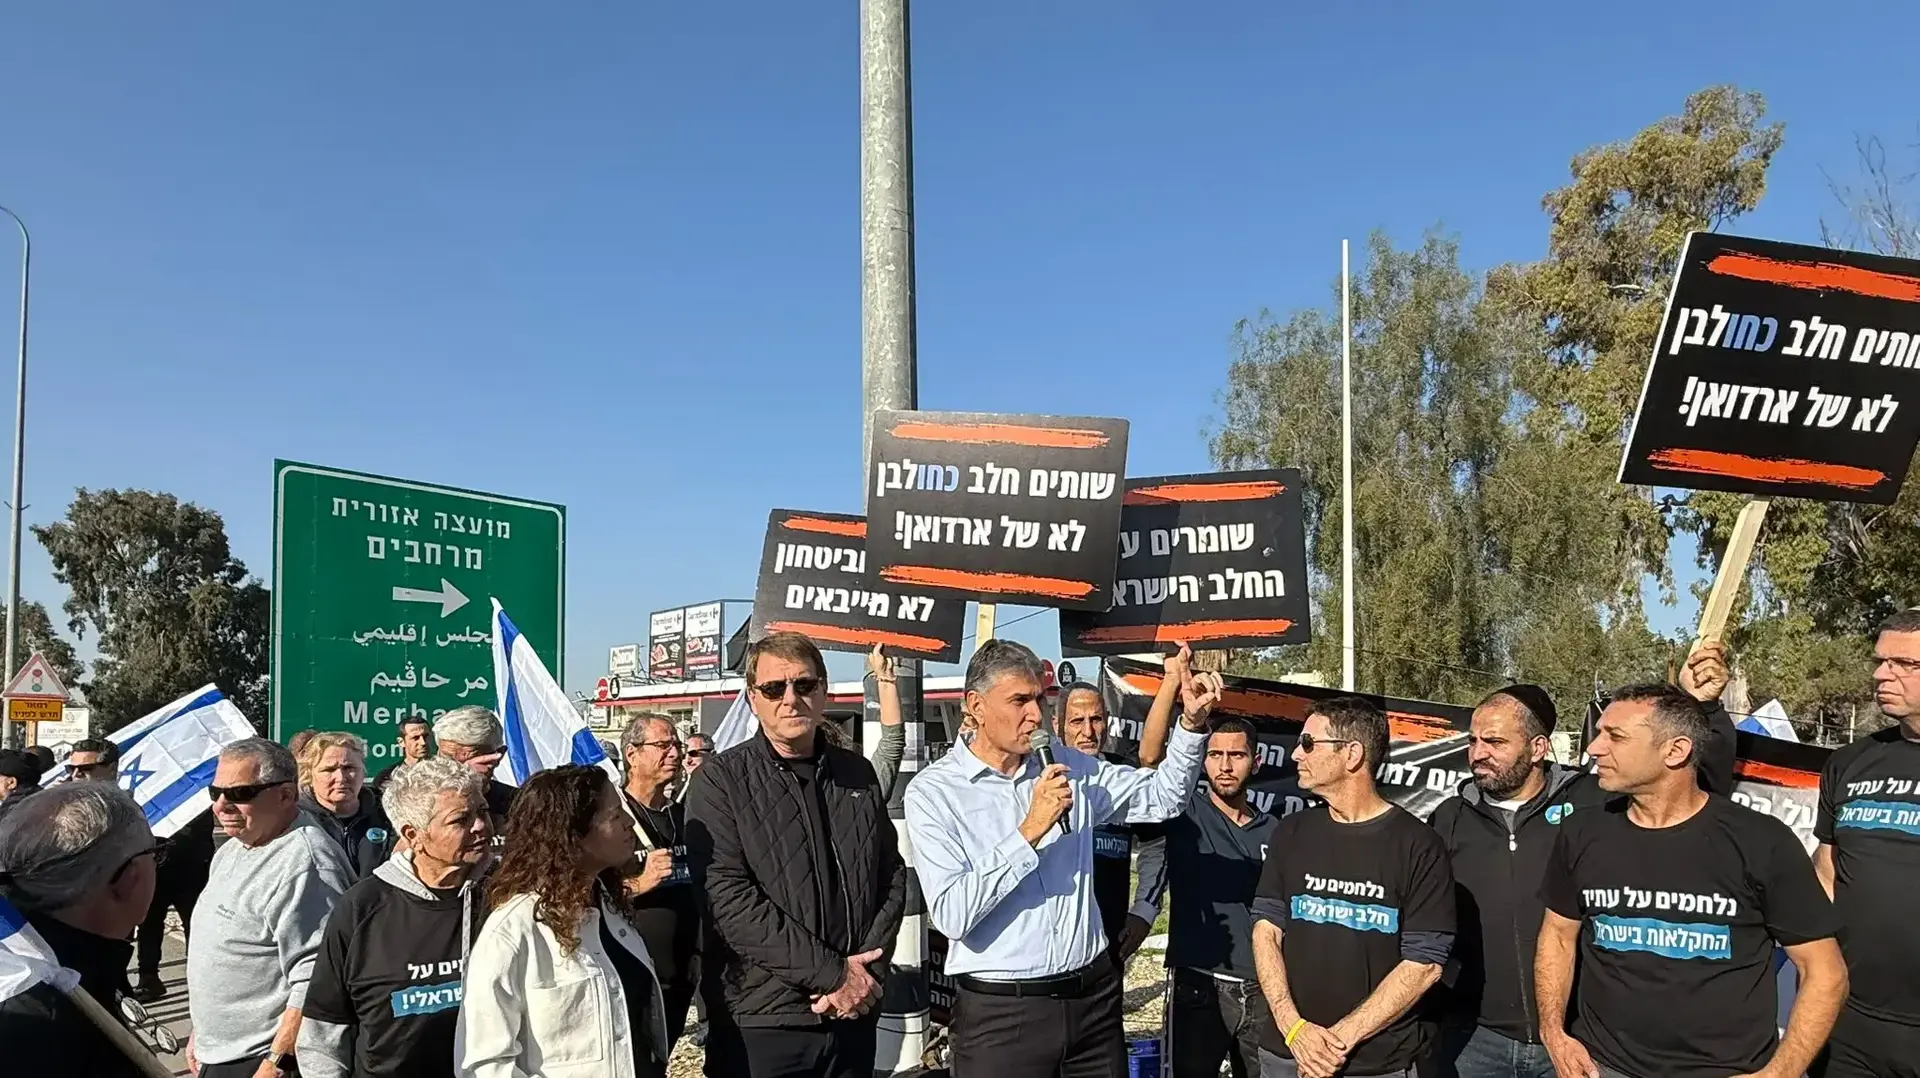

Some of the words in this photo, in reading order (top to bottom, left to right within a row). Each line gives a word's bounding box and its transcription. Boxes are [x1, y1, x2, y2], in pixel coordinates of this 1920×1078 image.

[1668, 304, 1779, 355] כחולבן
[1781, 315, 1847, 360] חלב
[1849, 328, 1920, 369] ותים
[1678, 376, 1799, 427] ארדואן!
[1803, 386, 1852, 428] של
[1851, 393, 1899, 434] לא
[876, 458, 960, 498] כחולבן
[966, 462, 1020, 496] חלב
[1028, 468, 1116, 501] שותים
[331, 497, 419, 526] אזורית
[434, 511, 511, 539] מועצה
[894, 510, 993, 550] ארדואן!
[1000, 515, 1041, 549] של
[1047, 518, 1087, 552] לא
[1120, 530, 1140, 559] ע
[1150, 522, 1255, 556] שומרים
[366, 535, 482, 570] מרחבים
[774, 542, 866, 574] וביטחון
[1112, 574, 1200, 607] הישרא
[1207, 567, 1286, 601] החלב
[784, 583, 890, 618] מייבאים
[897, 594, 935, 622] לא
[353, 623, 427, 647] إقليمي
[435, 625, 493, 648] جلس
[343, 700, 447, 725] Merha
[1846, 780, 1885, 797] עתיד
[1885, 777, 1913, 795] על
[1304, 873, 1327, 891] על
[1327, 878, 1385, 900] נלחמים
[1623, 885, 1652, 908] על
[1298, 899, 1354, 922] ישראלי!
[1582, 888, 1620, 908] עתיד
[1655, 891, 1738, 917] נלחמים
[1355, 904, 1390, 927] חלב
[1646, 925, 1729, 953] החקלאות
[407, 963, 434, 980] על
[401, 986, 463, 1010] שראלי!
